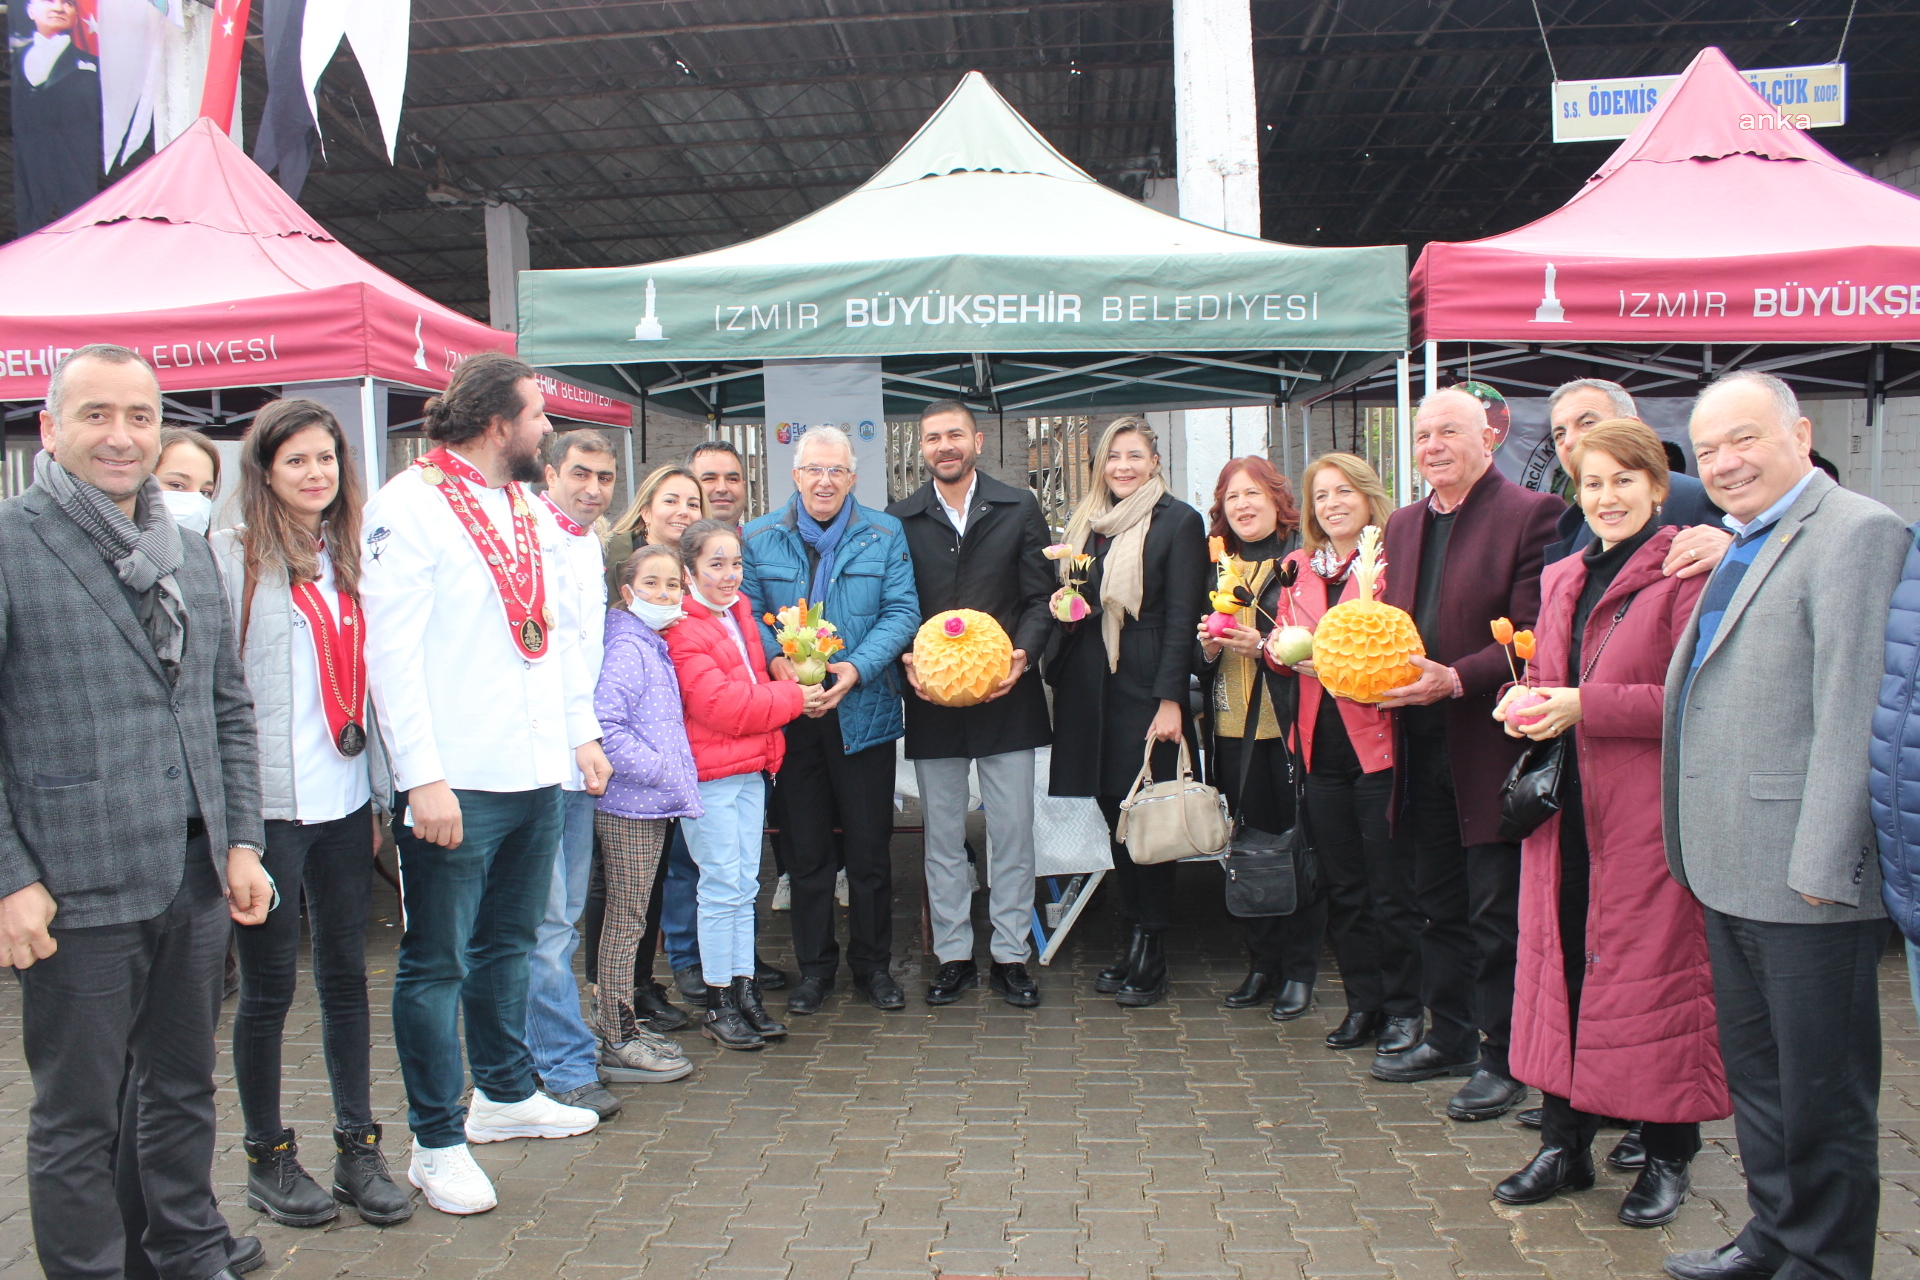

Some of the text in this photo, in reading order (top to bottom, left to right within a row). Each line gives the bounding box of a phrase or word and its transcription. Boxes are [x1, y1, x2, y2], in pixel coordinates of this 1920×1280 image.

[1814, 84, 1840, 103] KOOP.
[846, 289, 1082, 328] BÜYÜKŞEHİR
[1102, 292, 1319, 322] BELEDİYESİ
[1619, 289, 1727, 317] İZMİR
